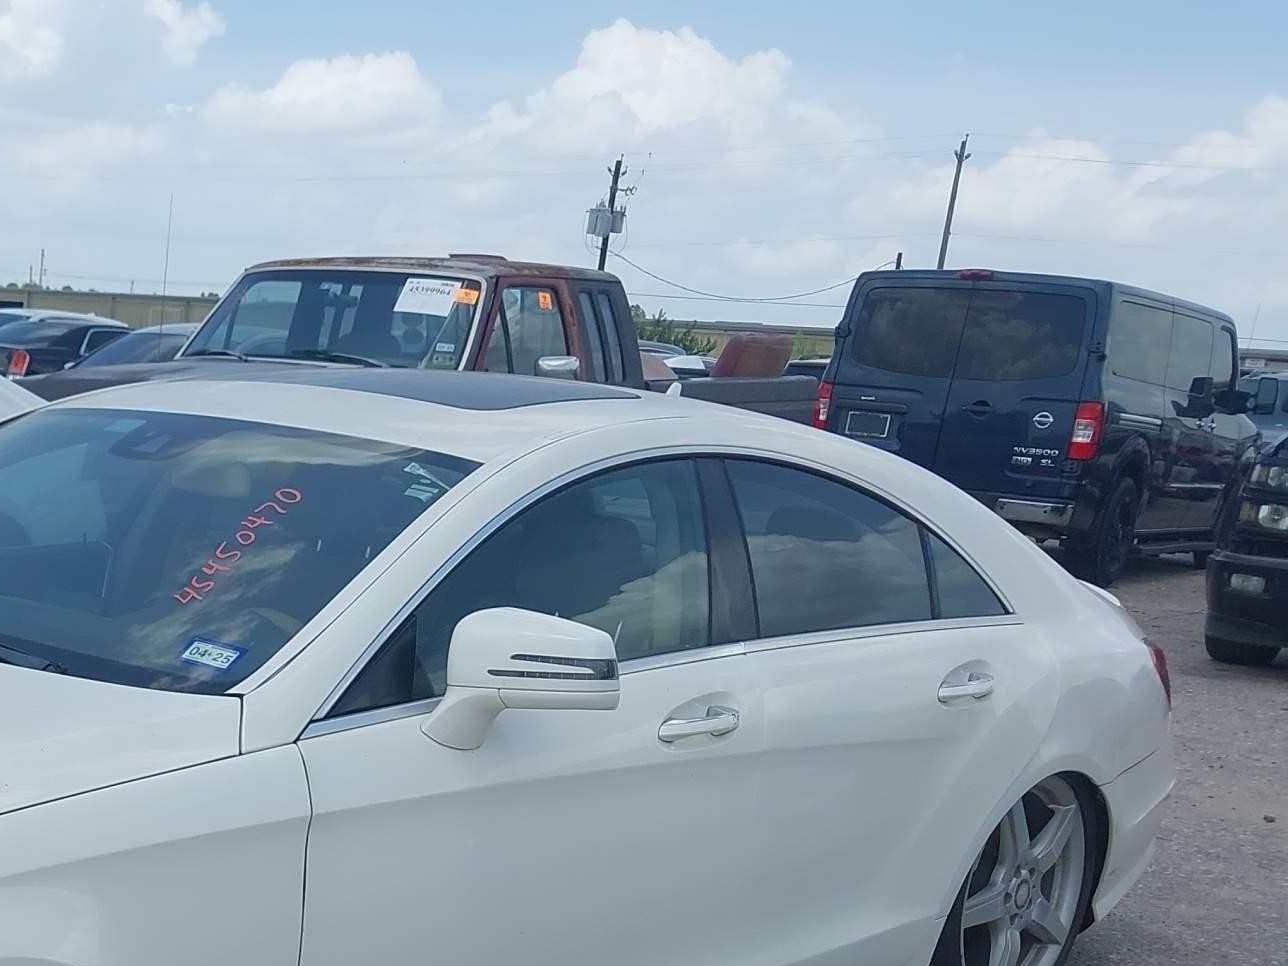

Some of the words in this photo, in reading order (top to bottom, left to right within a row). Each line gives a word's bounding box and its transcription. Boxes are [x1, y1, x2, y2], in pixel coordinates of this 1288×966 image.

[1012, 446, 1059, 457] NV3500
[1040, 458, 1056, 467] SL
[173, 488, 302, 604] 45450470
[211, 652, 234, 664] 25
